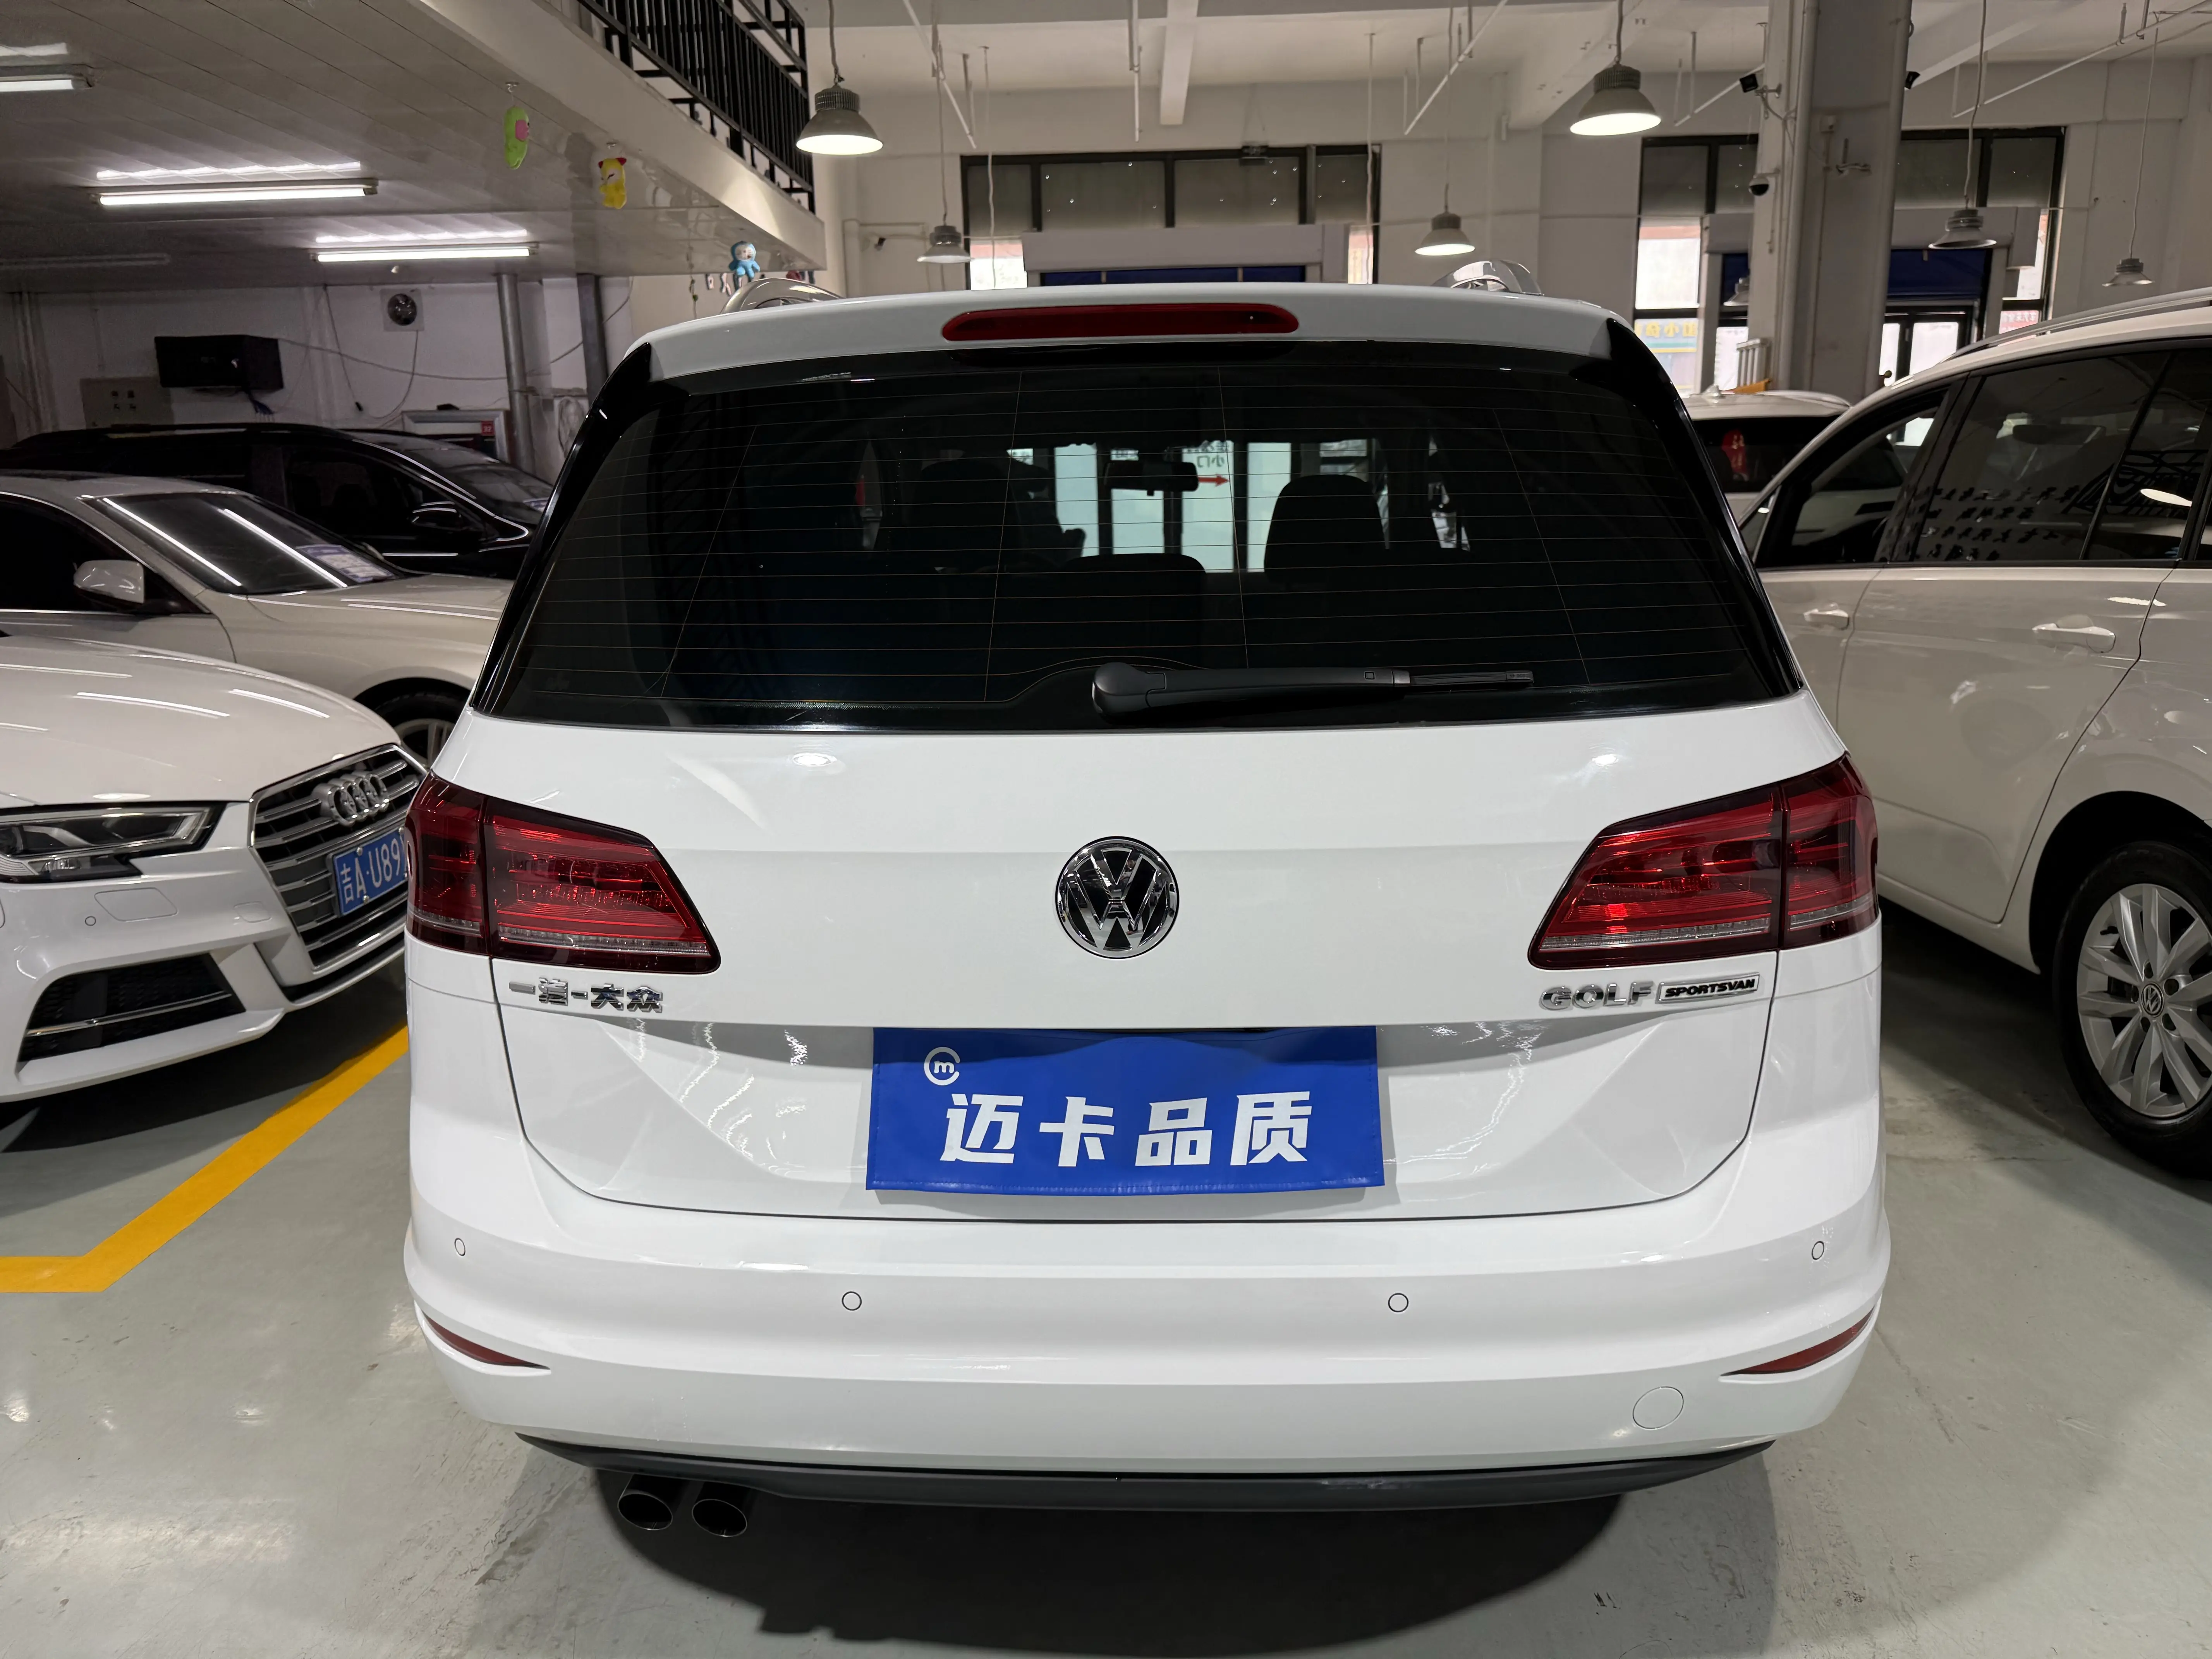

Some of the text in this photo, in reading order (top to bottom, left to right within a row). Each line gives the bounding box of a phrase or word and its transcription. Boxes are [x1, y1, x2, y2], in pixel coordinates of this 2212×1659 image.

[1541, 979, 1755, 1010] GOLF SPORTSVAN
[939, 1091, 1312, 1167] 迈卡品质
